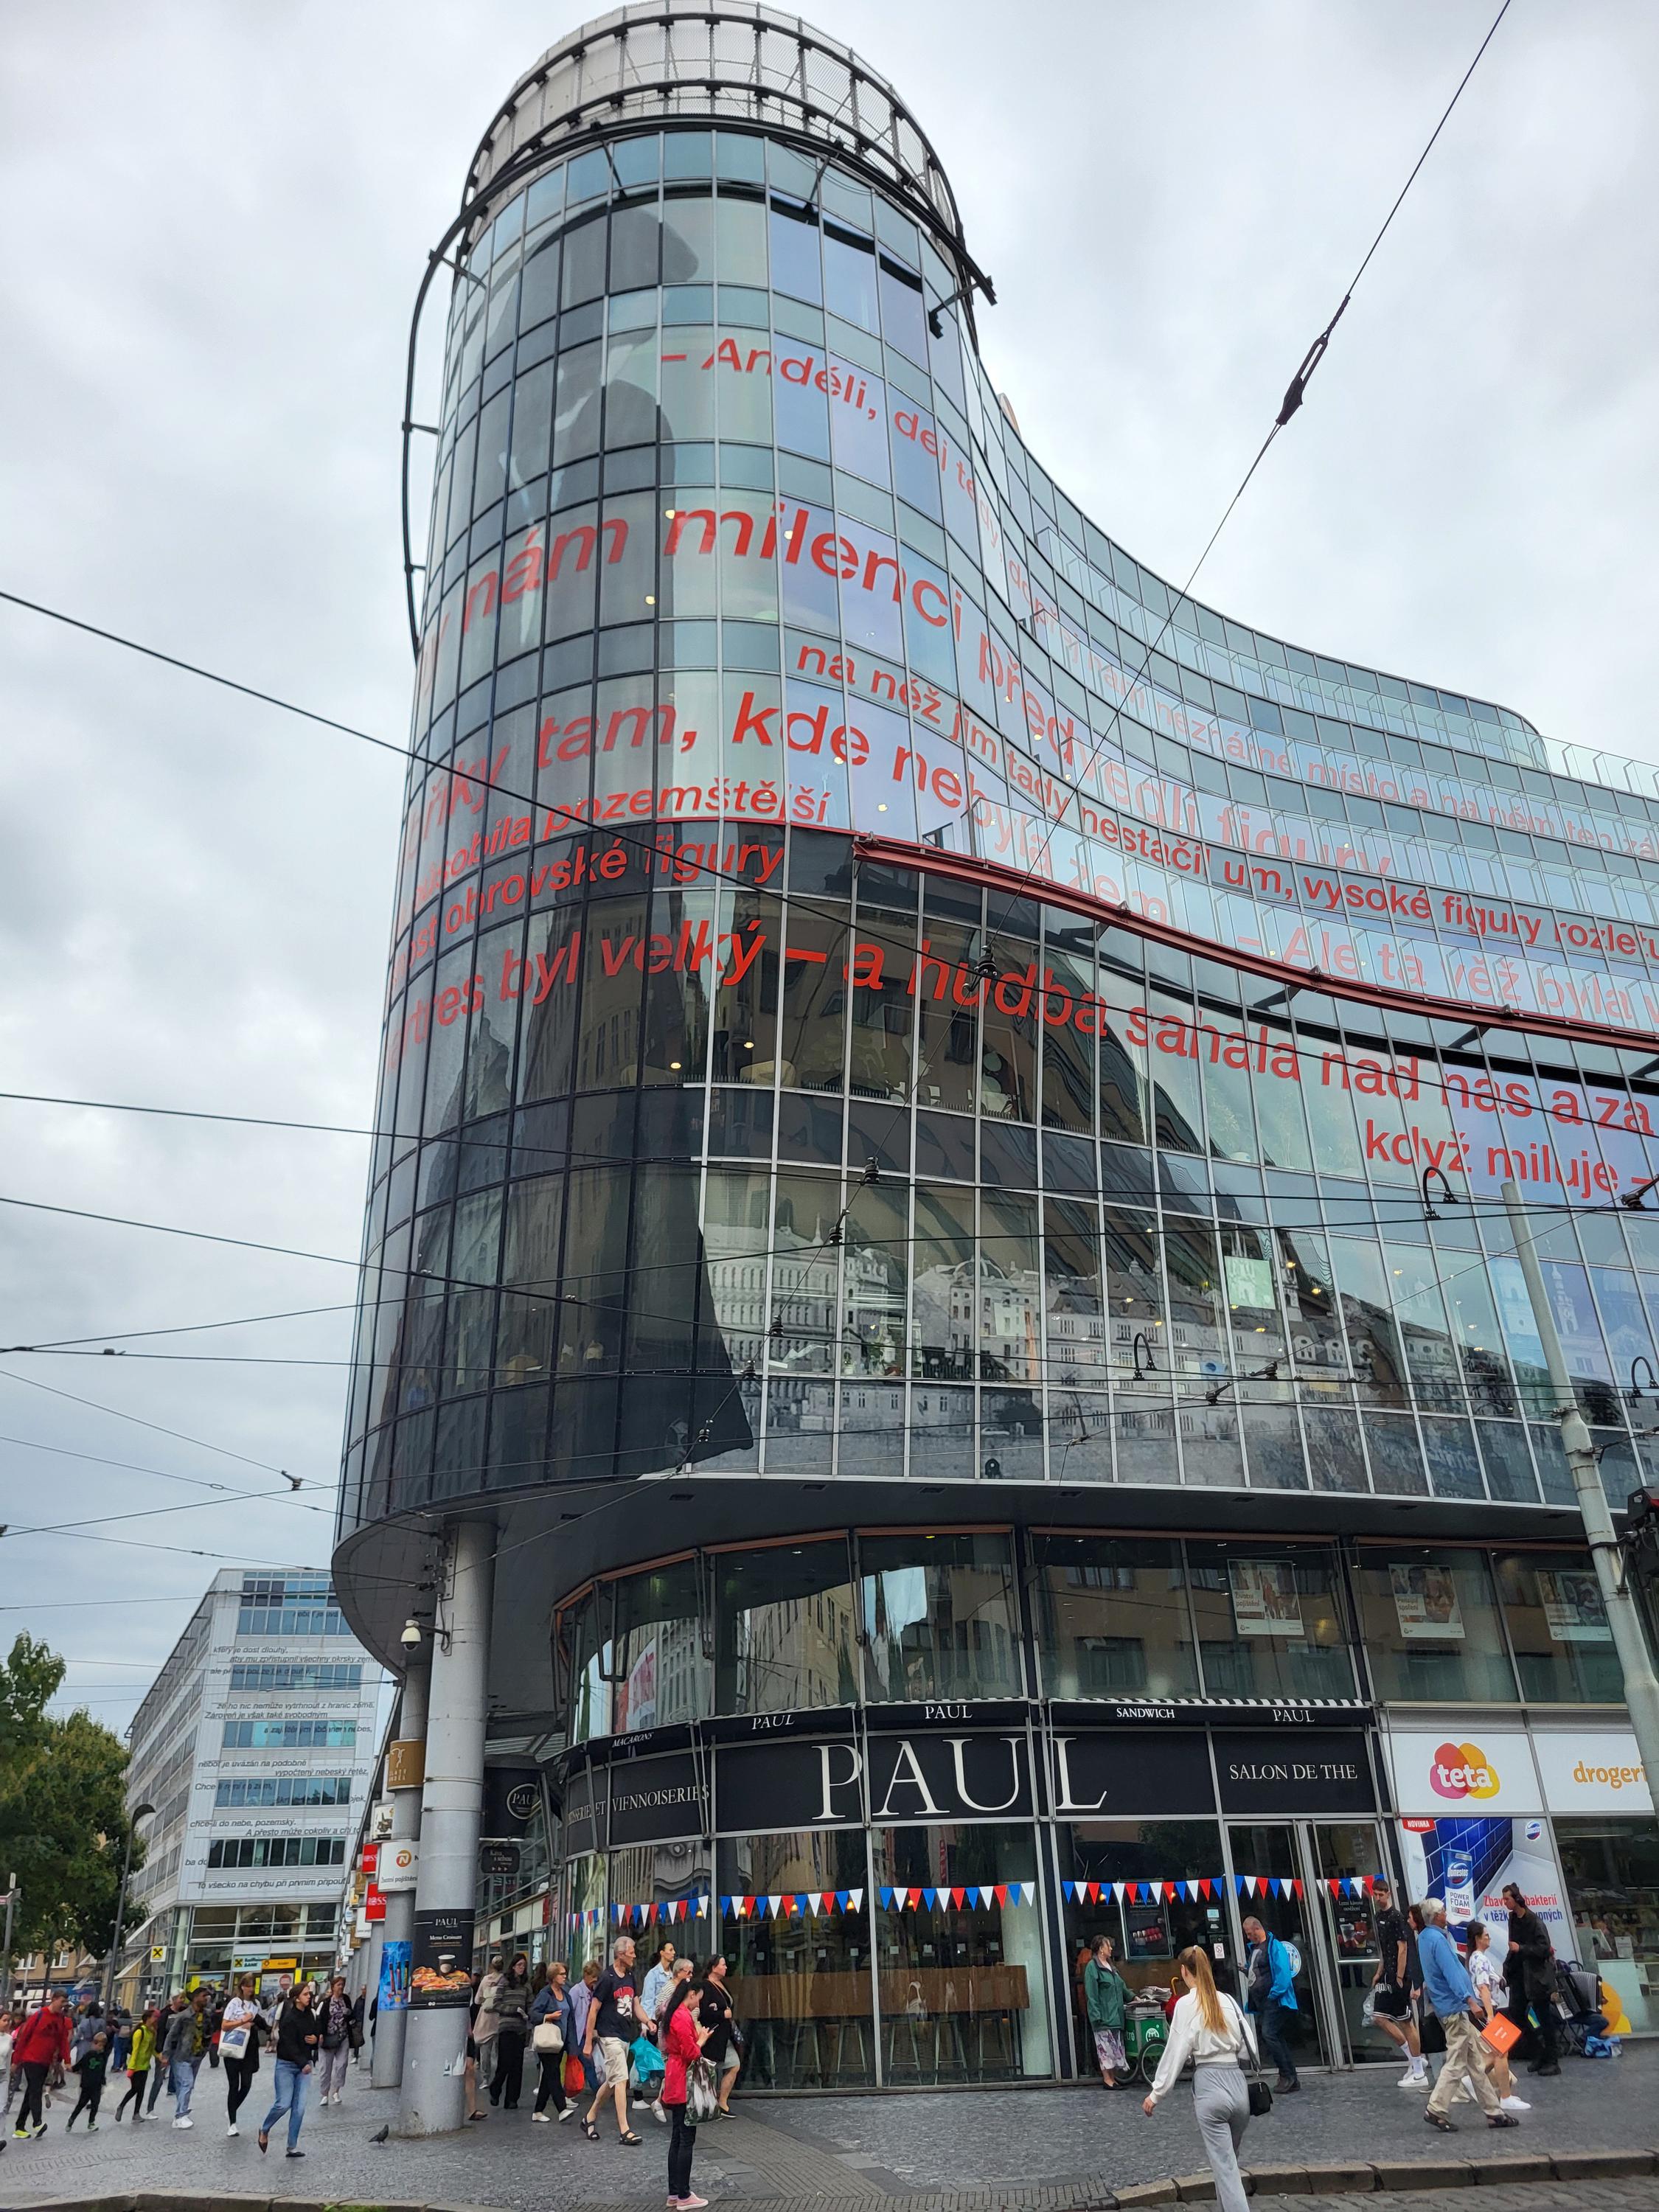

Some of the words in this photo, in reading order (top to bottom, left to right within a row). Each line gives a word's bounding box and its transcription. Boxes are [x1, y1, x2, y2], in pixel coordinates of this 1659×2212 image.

[894, 410, 947, 472] dej
[664, 503, 961, 642] milenci
[797, 645, 855, 684] na
[1007, 749, 1069, 818] tady
[1082, 806, 1211, 877] nestačil
[1224, 860, 1293, 900] um,
[1304, 875, 1431, 919] vysoké
[1443, 895, 1542, 945] figury
[537, 700, 698, 769] tam,
[731, 691, 870, 768] kde
[1377, 943, 1427, 987] ta
[445, 838, 627, 934] obrovské
[643, 834, 785, 884] figury
[499, 931, 581, 1006] byl
[602, 919, 767, 986] velký
[843, 942, 884, 991] a
[906, 939, 1107, 1037] hudba
[1126, 1004, 1299, 1082] sahala
[1322, 1049, 1419, 1101] nad
[1552, 1090, 1584, 1126] a
[1366, 1119, 1472, 1178] když
[1487, 1143, 1619, 1199] miluje
[924, 1705, 973, 1720] PAUL
[1116, 1707, 1175, 1719] SANDWICH
[1273, 1709, 1315, 1723] PAUL
[751, 1714, 796, 1731] PAUL
[612, 1732, 654, 1748] MACARONS
[812, 1738, 1107, 1820] PAUL
[1229, 1764, 1288, 1781] SALON
[1292, 1764, 1321, 1780] DE
[1324, 1764, 1358, 1781] THE
[1436, 1764, 1493, 1788] teta
[595, 1801, 606, 1816] ET
[613, 1784, 709, 1813] VIENNOISERIES
[304, 1827, 332, 1836] cokoliv
[1407, 1819, 1430, 1829] NOVINKA
[1447, 1866, 1469, 1877] Domestos
[1450, 1892, 1470, 1901] POWER
[1450, 1899, 1470, 1908] FOAM
[435, 1918, 459, 1926] PAUL
